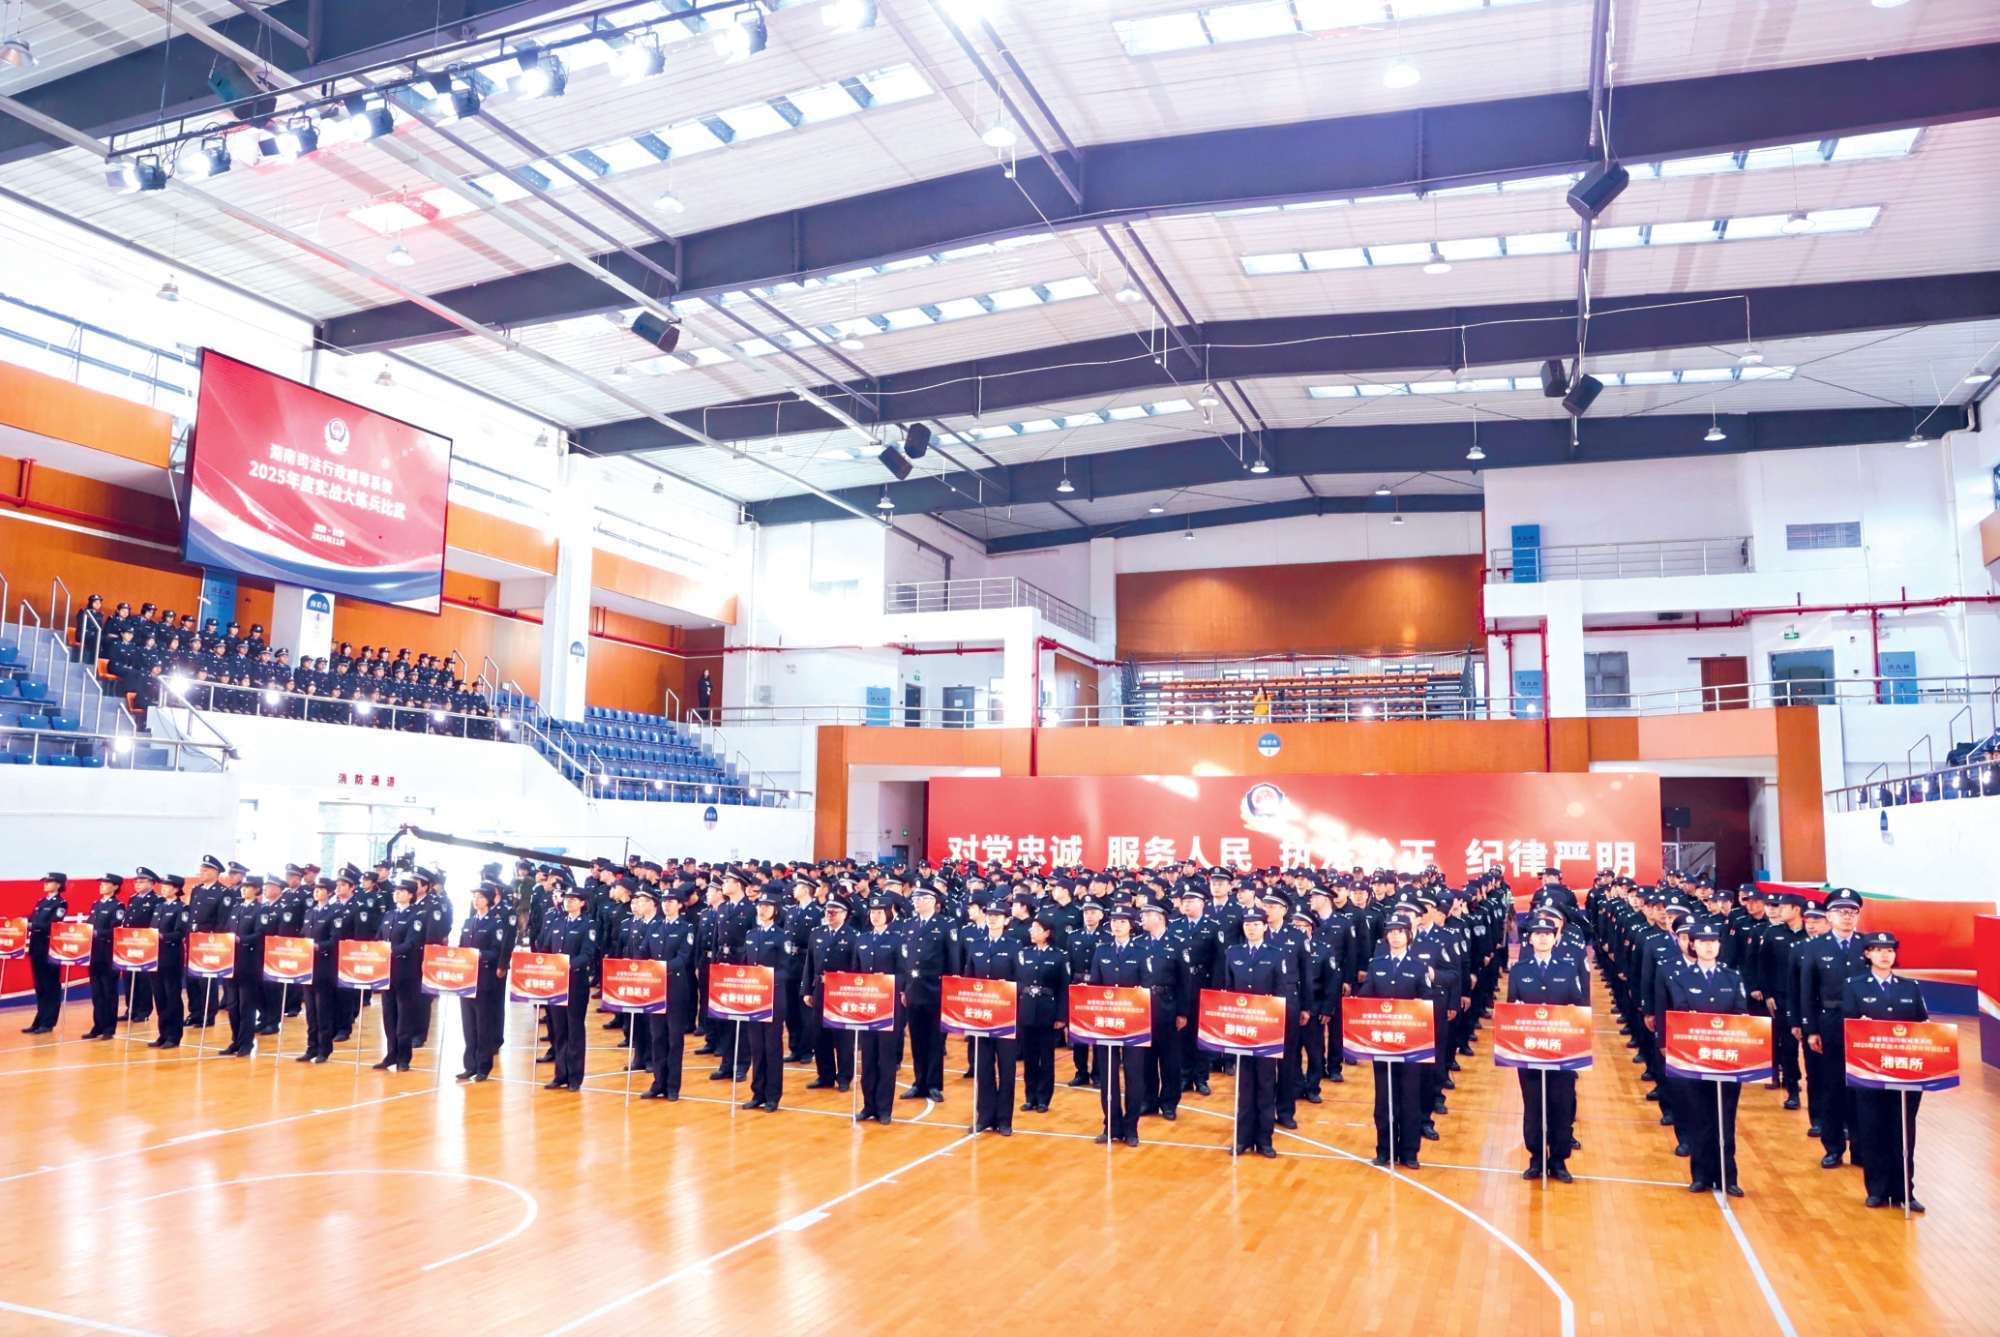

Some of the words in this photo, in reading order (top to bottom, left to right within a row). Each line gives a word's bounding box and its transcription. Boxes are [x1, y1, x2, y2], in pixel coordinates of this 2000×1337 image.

[249, 460, 406, 520] 2025年度实战大练兵比武
[338, 773, 396, 788] 消防通道
[948, 834, 1083, 868] 对党忠诚
[1107, 836, 1252, 871] 服务人民
[1465, 838, 1636, 878] 纪律严明
[841, 1002, 876, 1014] 省女子所
[964, 1007, 992, 1020] 长沙所
[1094, 1017, 1125, 1029] 湘潭所
[1225, 1024, 1258, 1038] 邵阳所
[1371, 1030, 1406, 1043] 常德所
[1524, 1037, 1562, 1051] 郴州所
[1698, 1047, 1739, 1062] 娄底所
[1880, 1055, 1924, 1070] 湘西所
